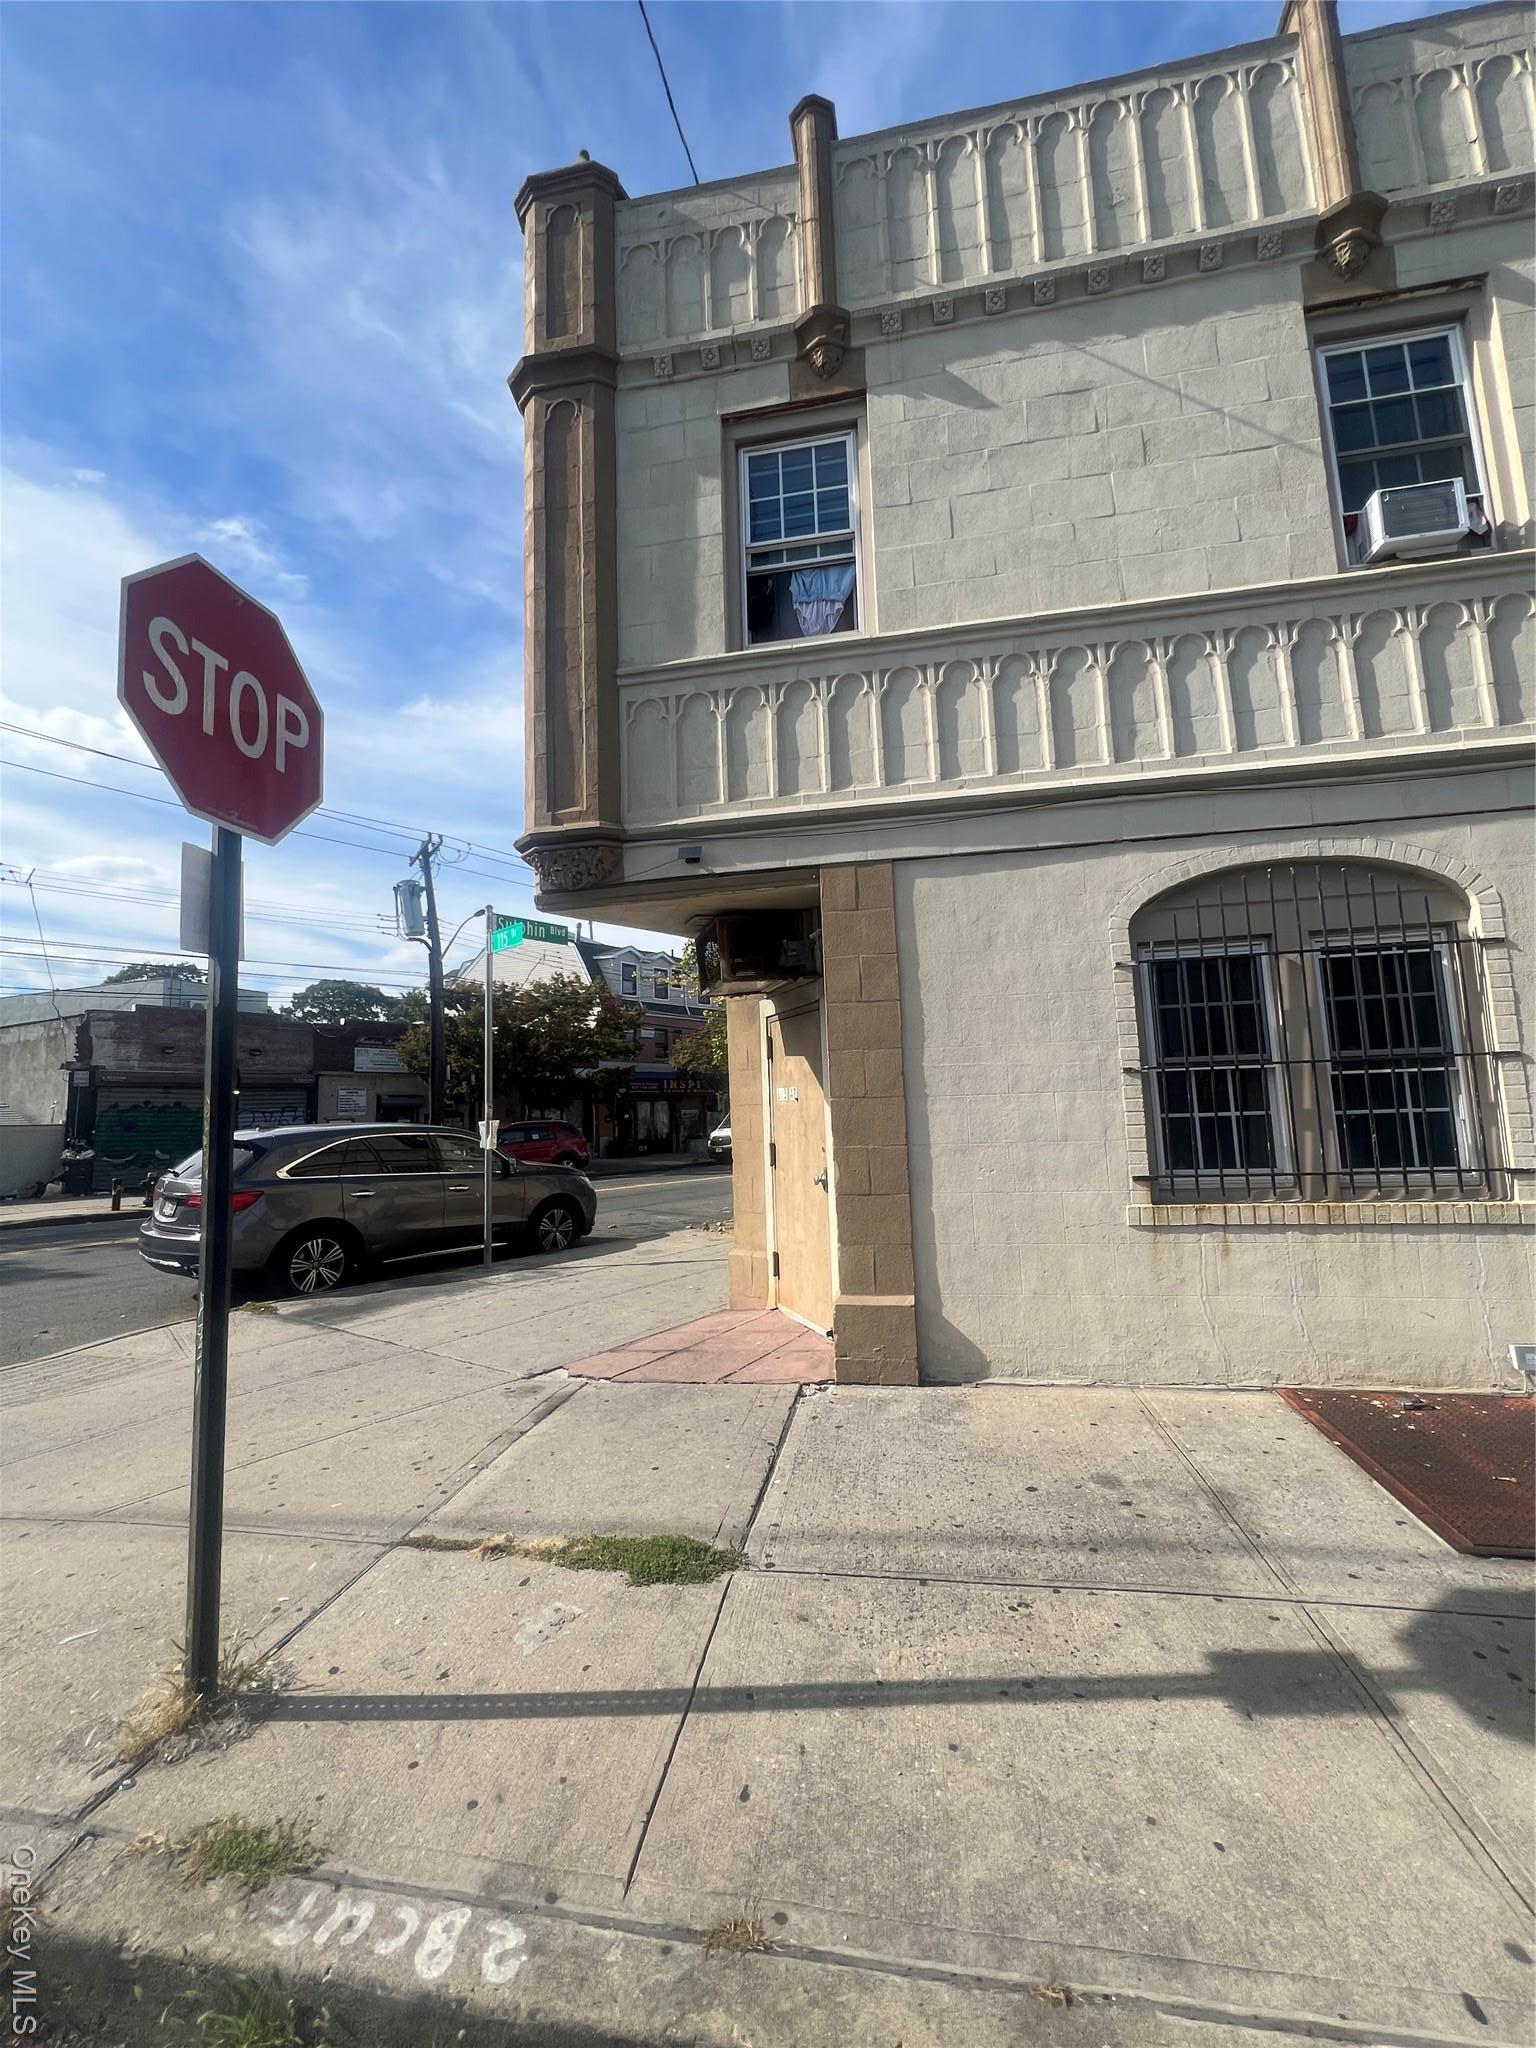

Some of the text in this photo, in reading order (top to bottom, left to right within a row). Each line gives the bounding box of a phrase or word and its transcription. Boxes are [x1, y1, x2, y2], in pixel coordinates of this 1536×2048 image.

[143, 616, 309, 774] STOP
[497, 930, 508, 948] 115
[550, 926, 566, 937] Blvd
